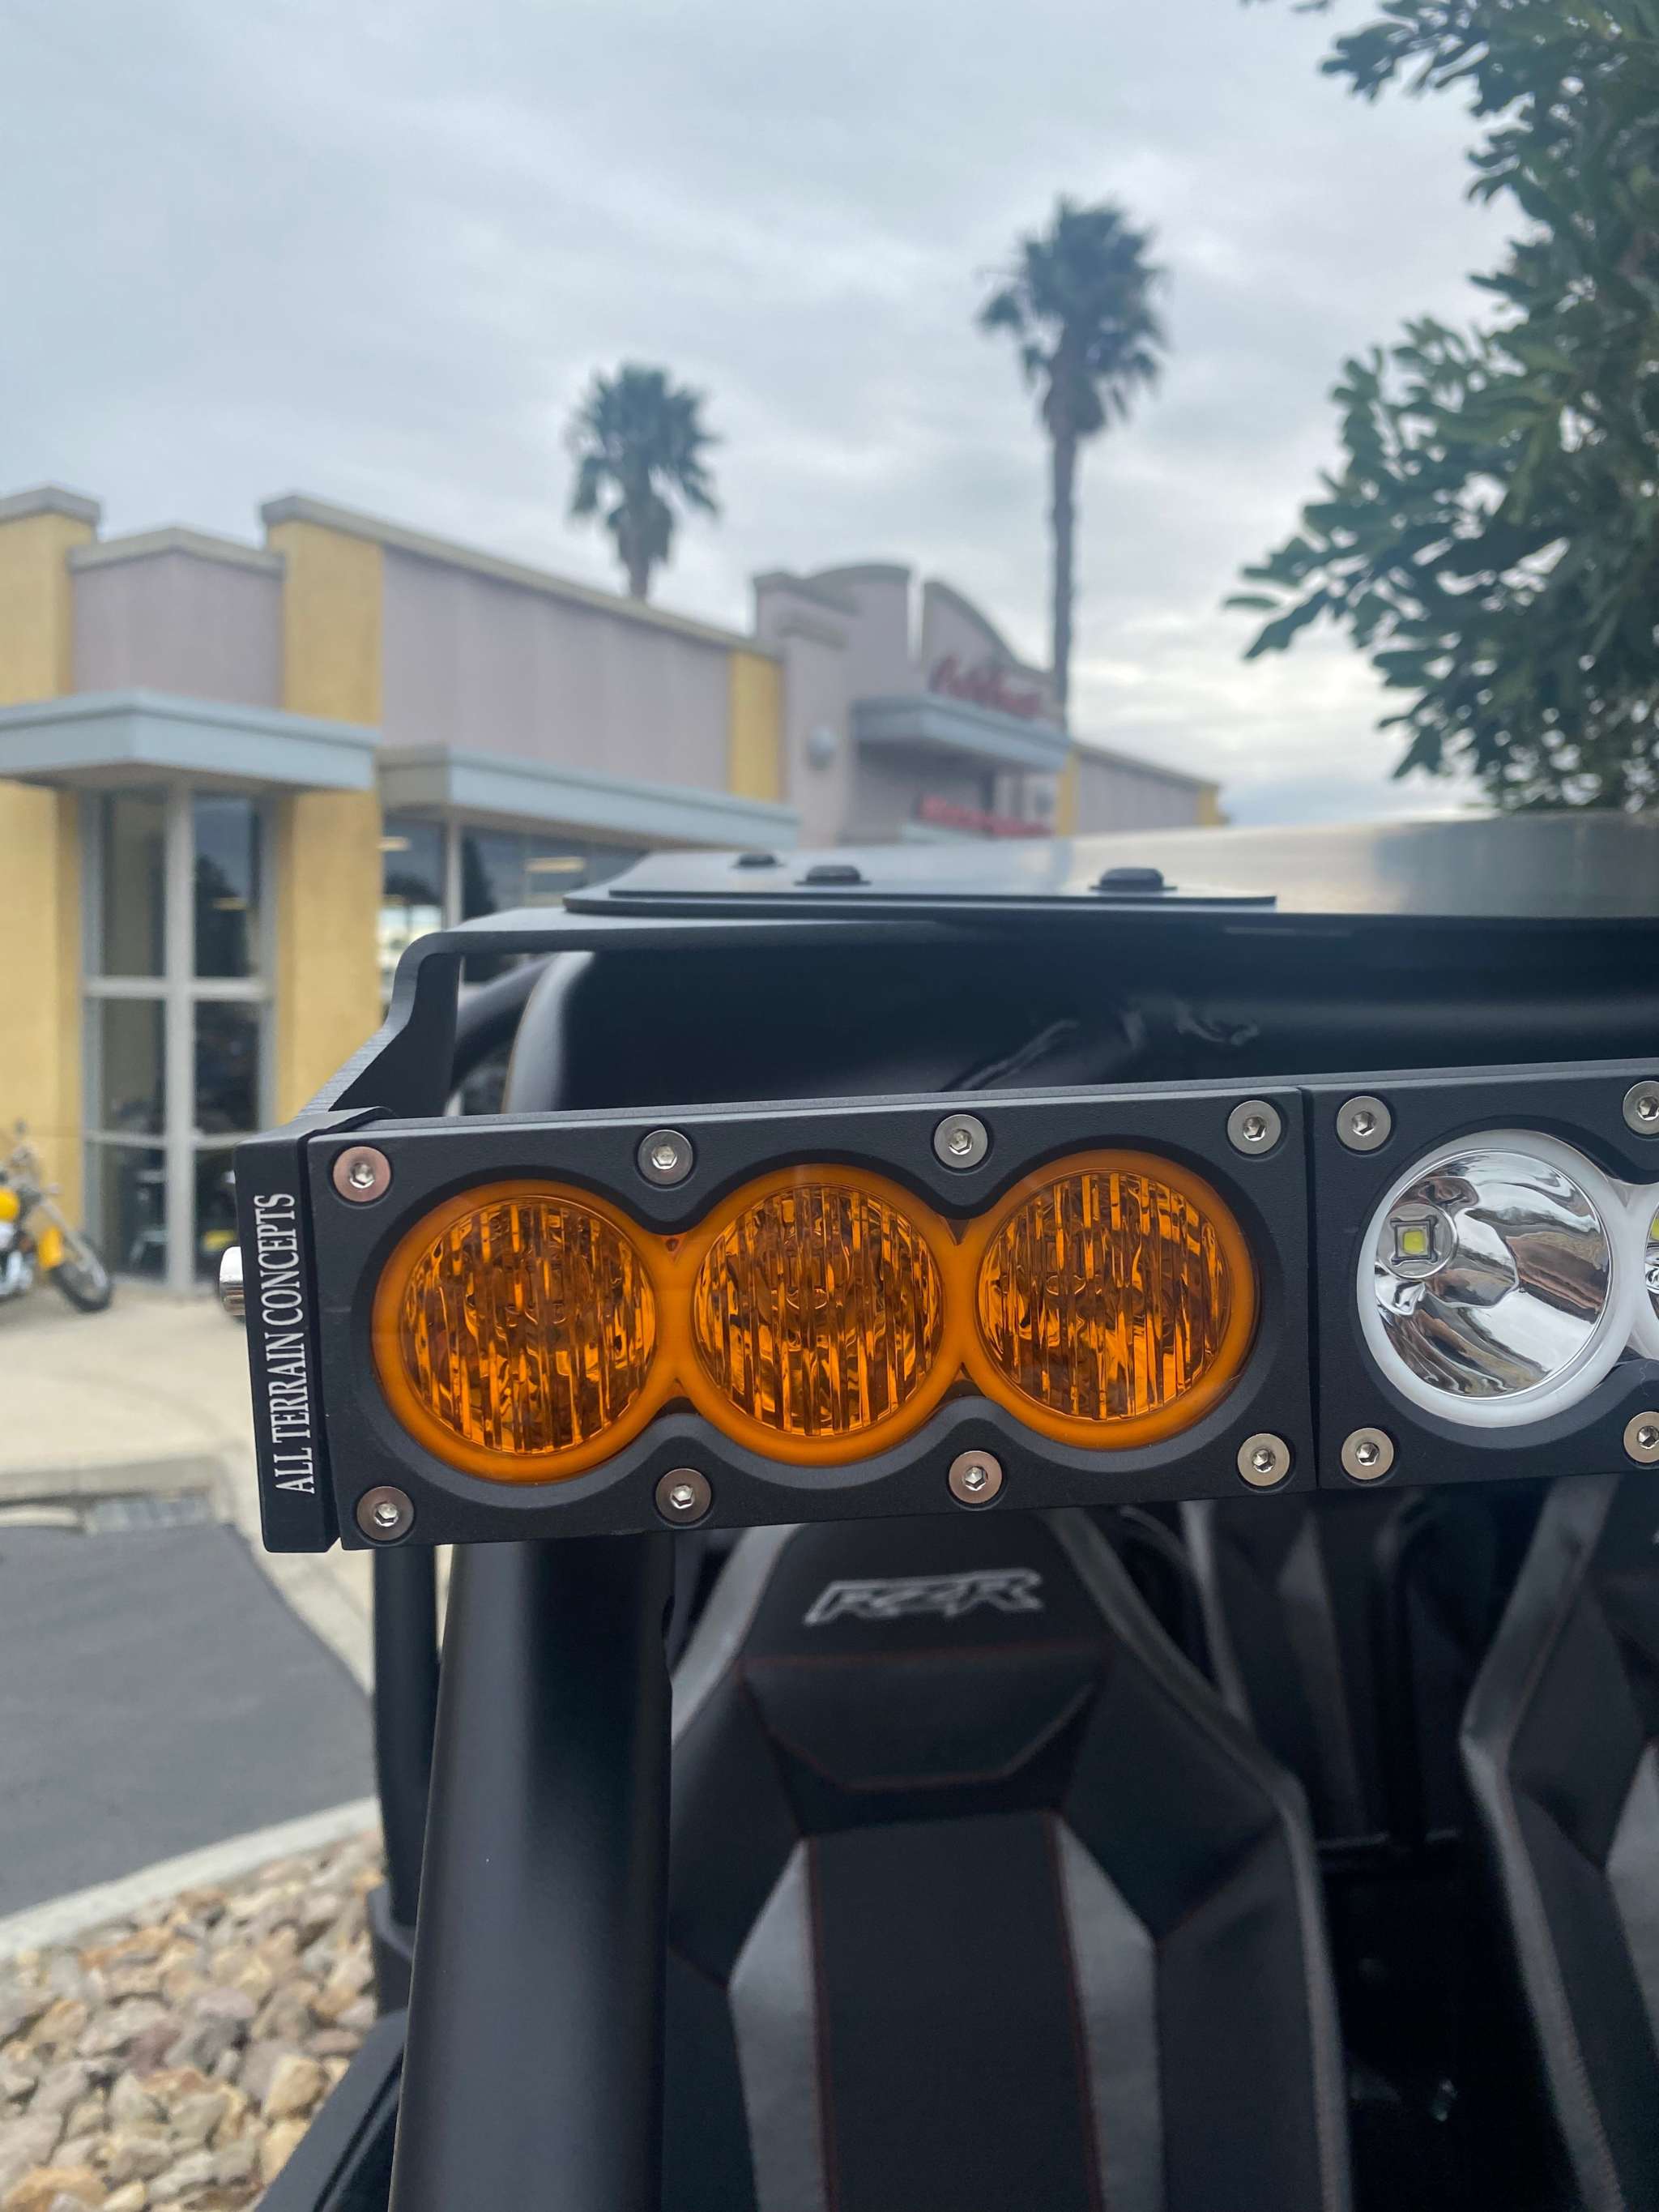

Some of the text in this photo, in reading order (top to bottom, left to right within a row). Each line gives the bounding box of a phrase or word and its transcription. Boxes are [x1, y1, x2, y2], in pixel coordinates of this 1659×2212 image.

[254, 1194, 315, 1494] ALL TERRAIN CONCEPTS
